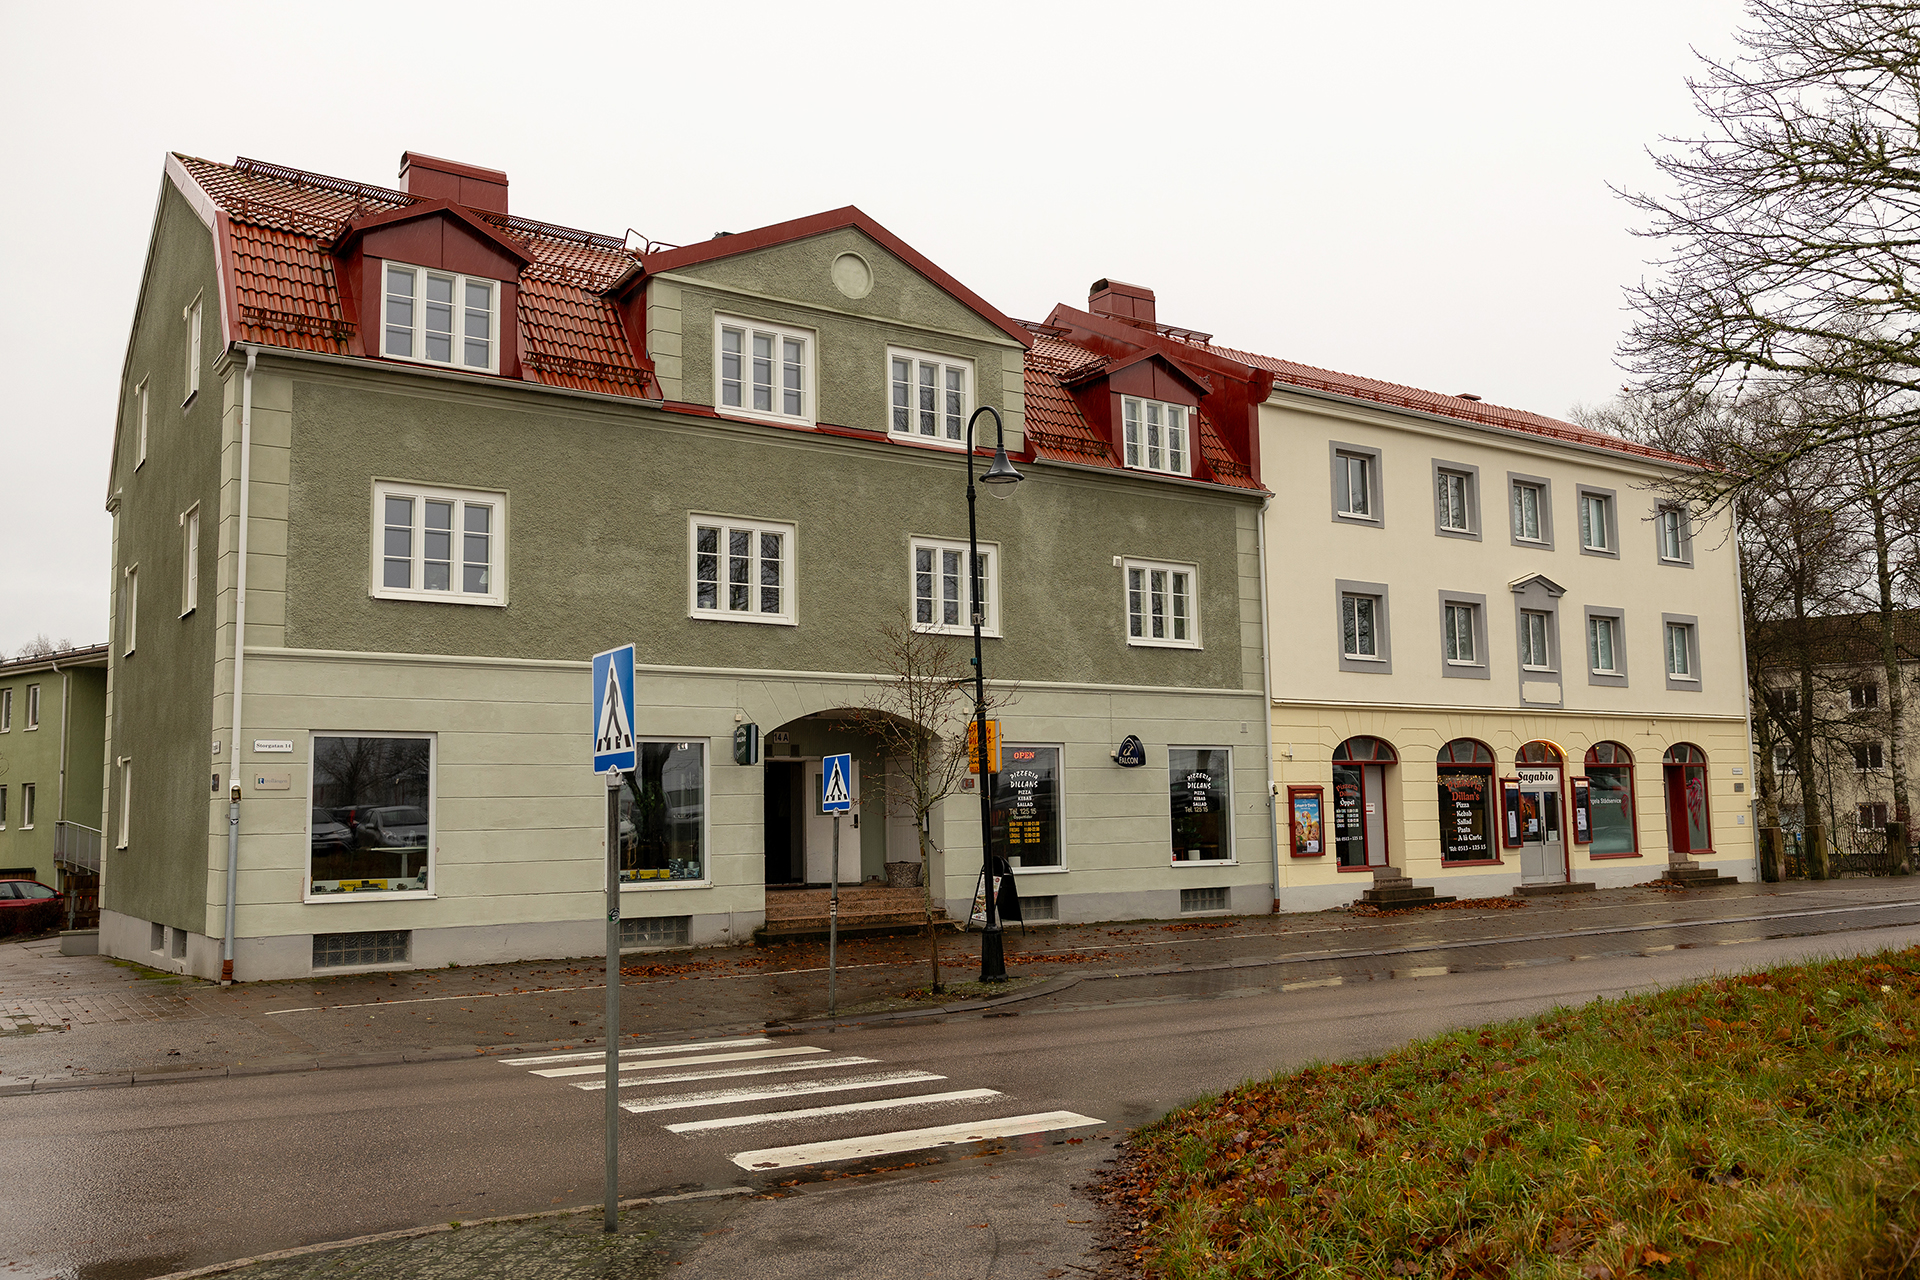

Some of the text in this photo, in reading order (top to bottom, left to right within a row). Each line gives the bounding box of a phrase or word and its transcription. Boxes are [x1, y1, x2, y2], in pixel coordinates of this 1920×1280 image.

[774, 733, 789, 742] 14 A
[1013, 751, 1035, 760] OPEN
[1119, 756, 1139, 765] FALCON
[1009, 770, 1039, 780] PIZZERIA
[1186, 772, 1212, 782] PIZZERIA
[1518, 771, 1554, 785] Sagabio
[1335, 784, 1358, 792] Pizzeria
[1447, 779, 1482, 792] Pizzeria
[1451, 791, 1480, 801] Dillan's
[1340, 798, 1355, 806] Öppet
